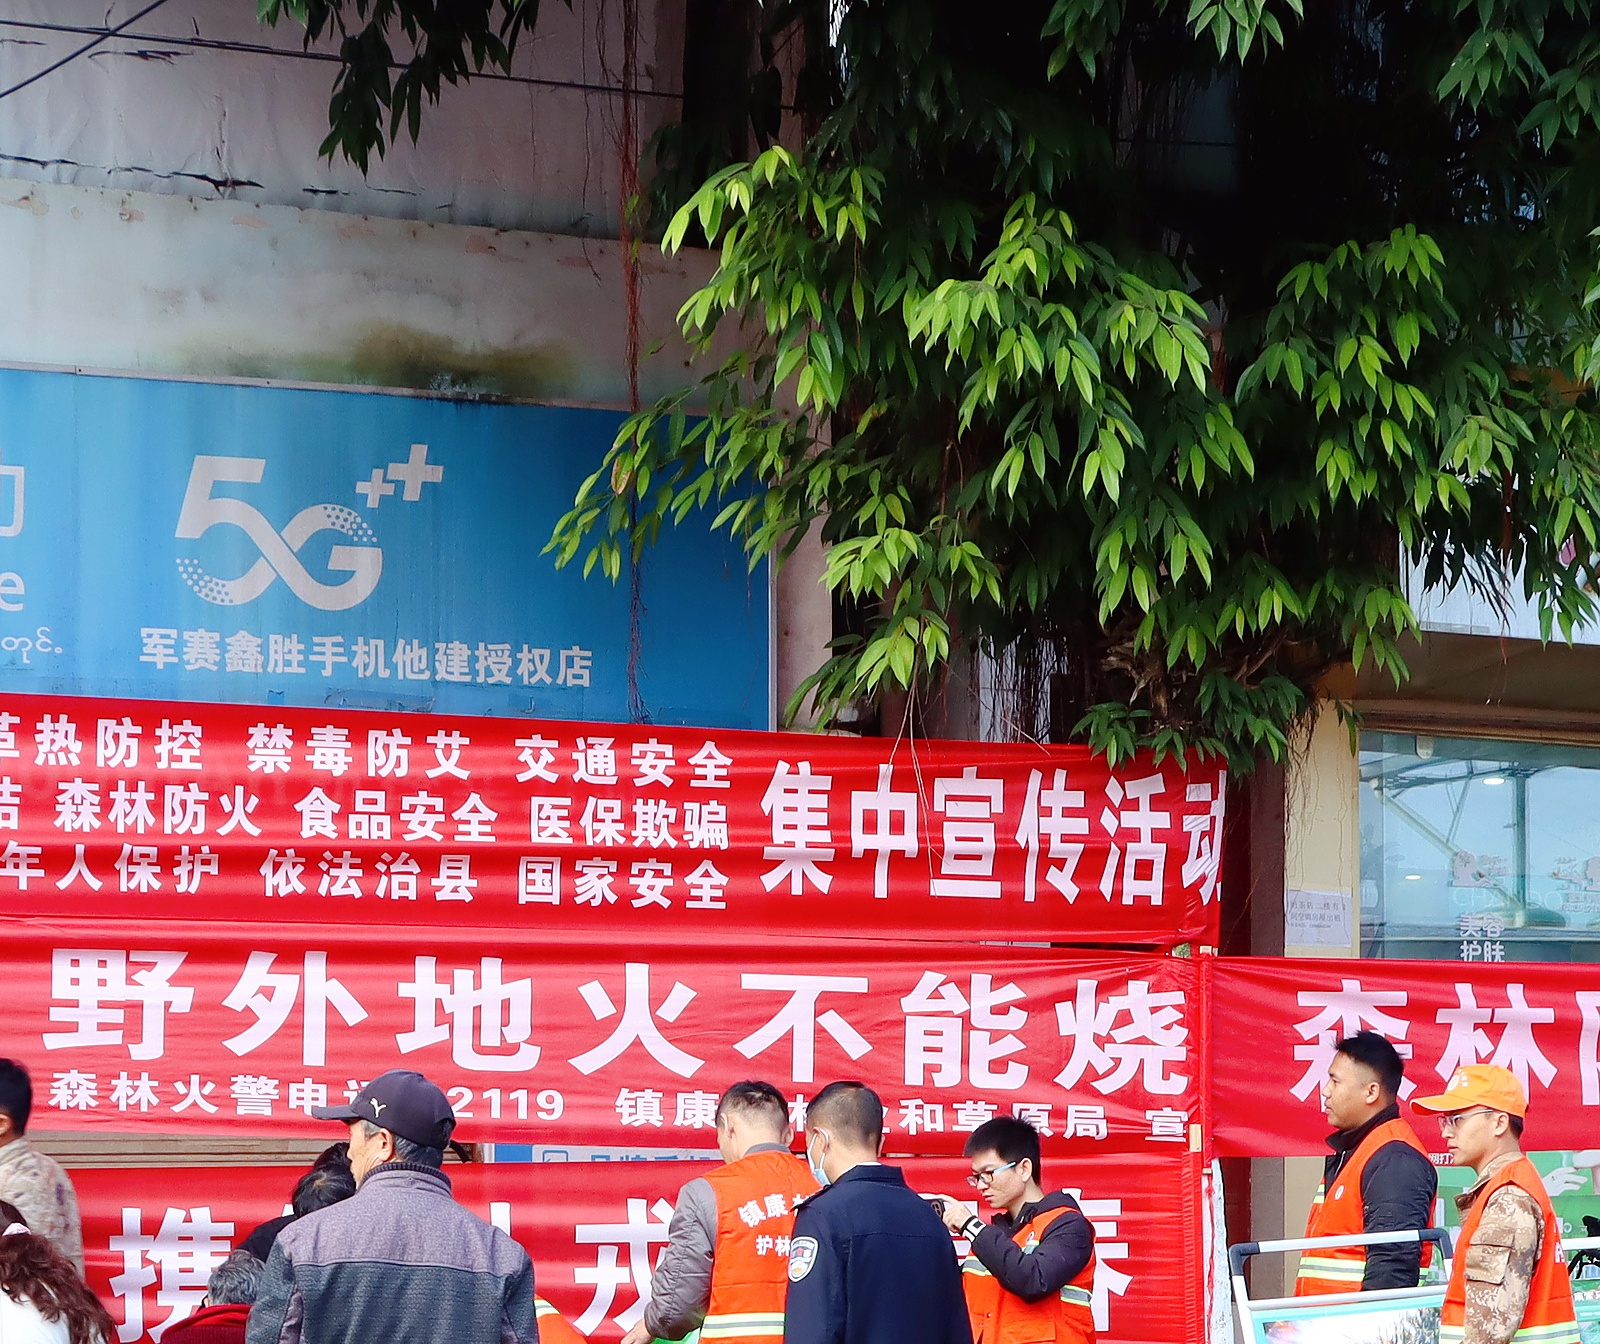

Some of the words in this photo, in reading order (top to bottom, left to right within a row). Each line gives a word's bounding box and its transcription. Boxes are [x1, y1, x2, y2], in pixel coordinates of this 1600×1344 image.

[139, 626, 592, 688] 军赛鑫胜手机他建授权店
[245, 722, 472, 780] 禁毒防艾
[514, 734, 733, 788] 交通安全
[52, 777, 263, 837] 森林防火
[293, 786, 498, 843] 食品安全
[530, 795, 729, 850] 医保欺骗
[259, 848, 478, 903] 依法治县
[518, 856, 730, 910] 国家安全
[1459, 914, 1504, 938] 美容
[1460, 940, 1505, 963] 护肤
[42, 941, 1189, 1095] 野外地火不能烧
[1144, 1106, 1190, 1143] 宣
